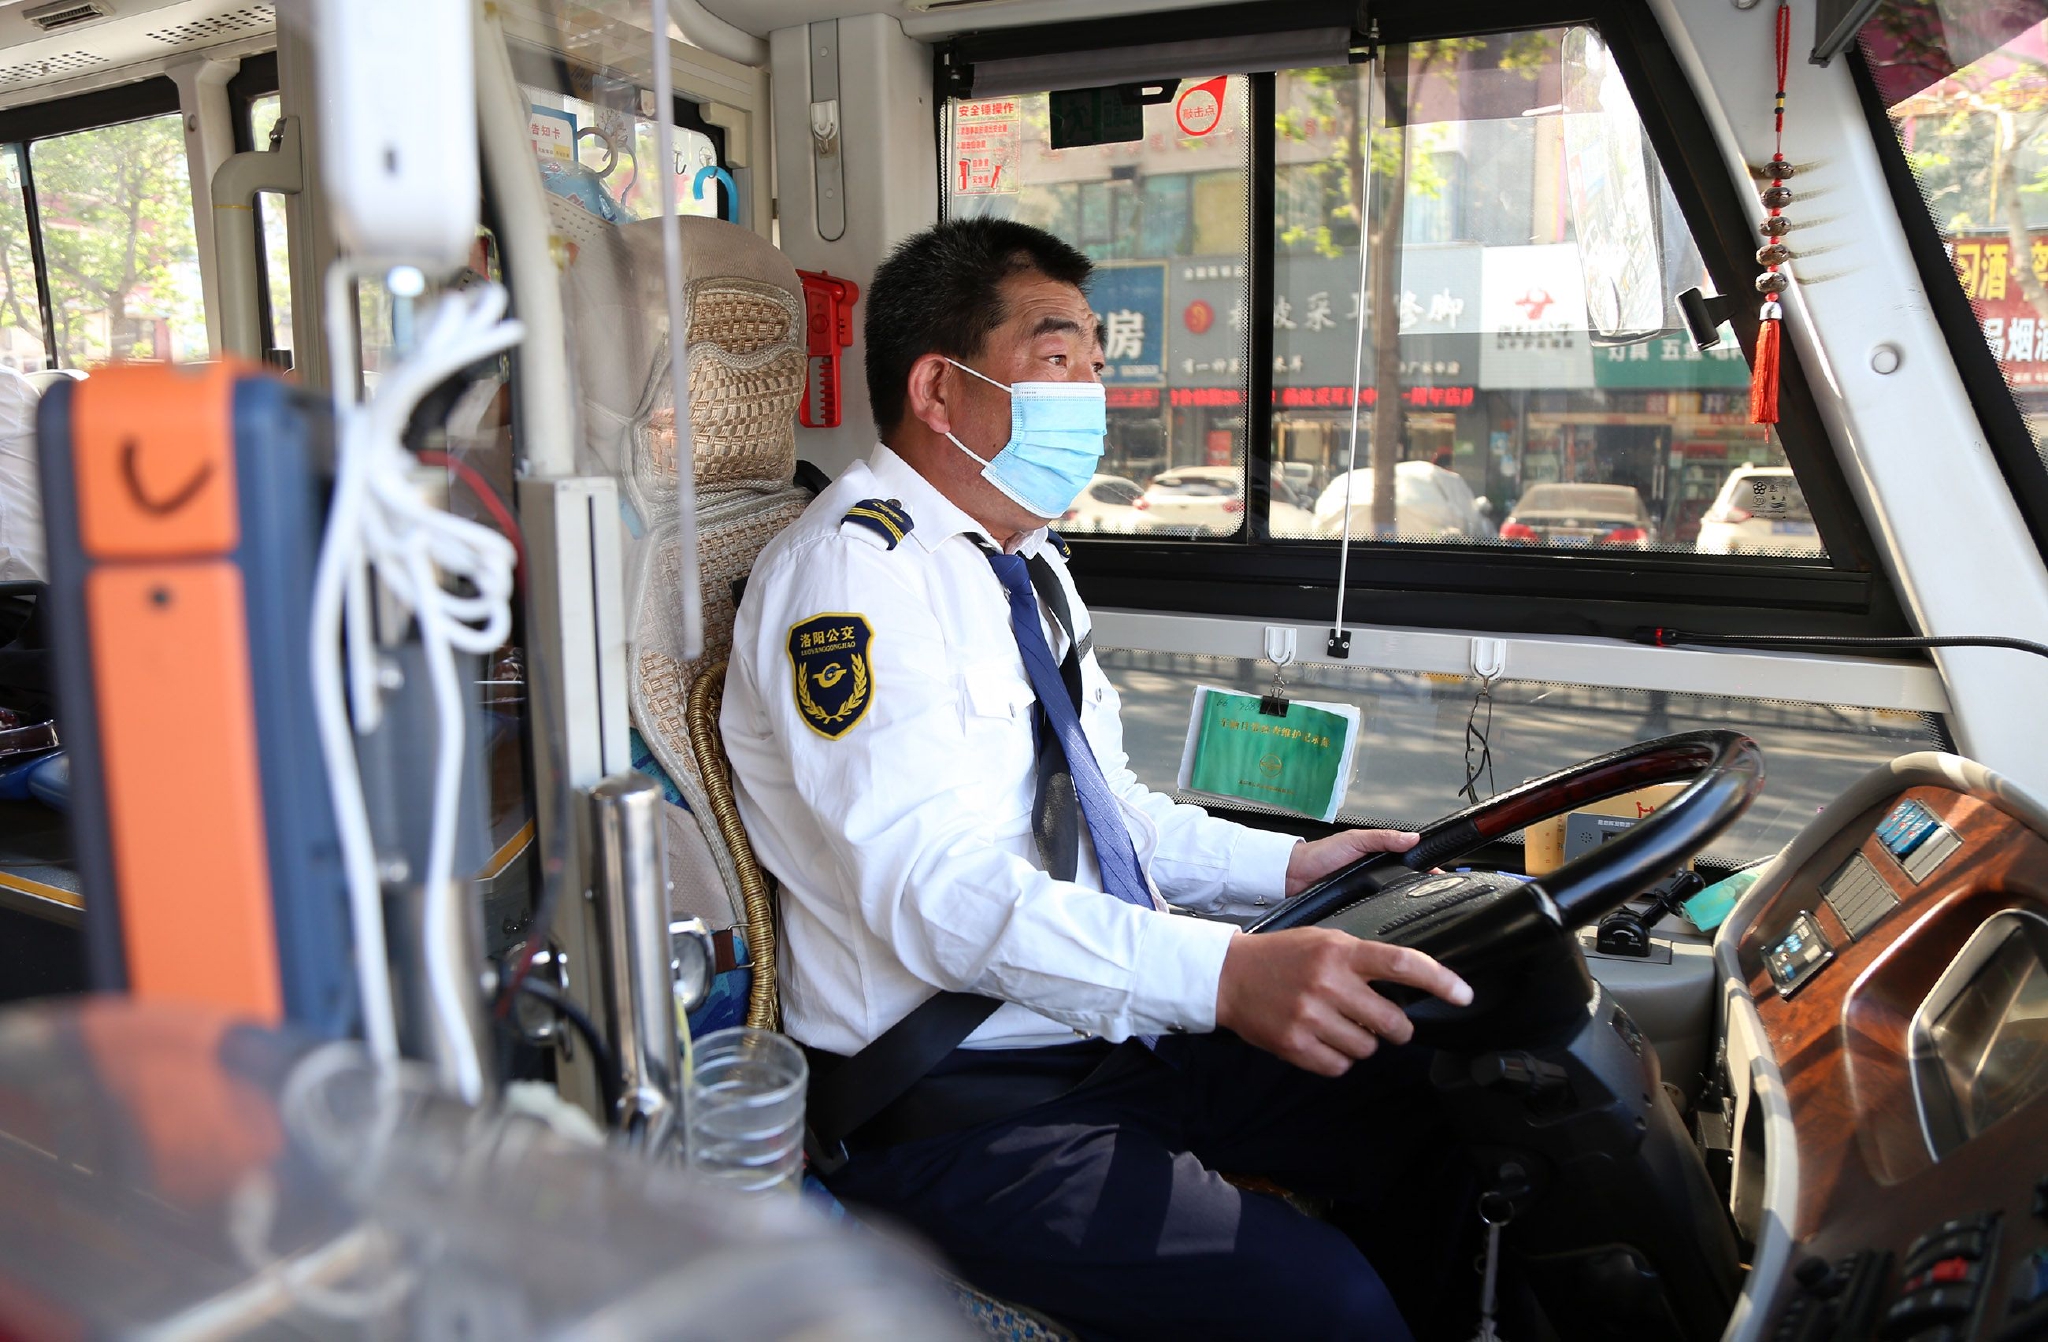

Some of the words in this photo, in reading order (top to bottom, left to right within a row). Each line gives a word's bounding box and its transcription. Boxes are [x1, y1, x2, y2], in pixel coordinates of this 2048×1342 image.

[958, 102, 1015, 117] 安全锤操作
[1182, 104, 1216, 120] 敲击点
[530, 123, 561, 140] 告知卡
[1098, 308, 1146, 360] 房
[799, 625, 855, 648] 洛阳公交
